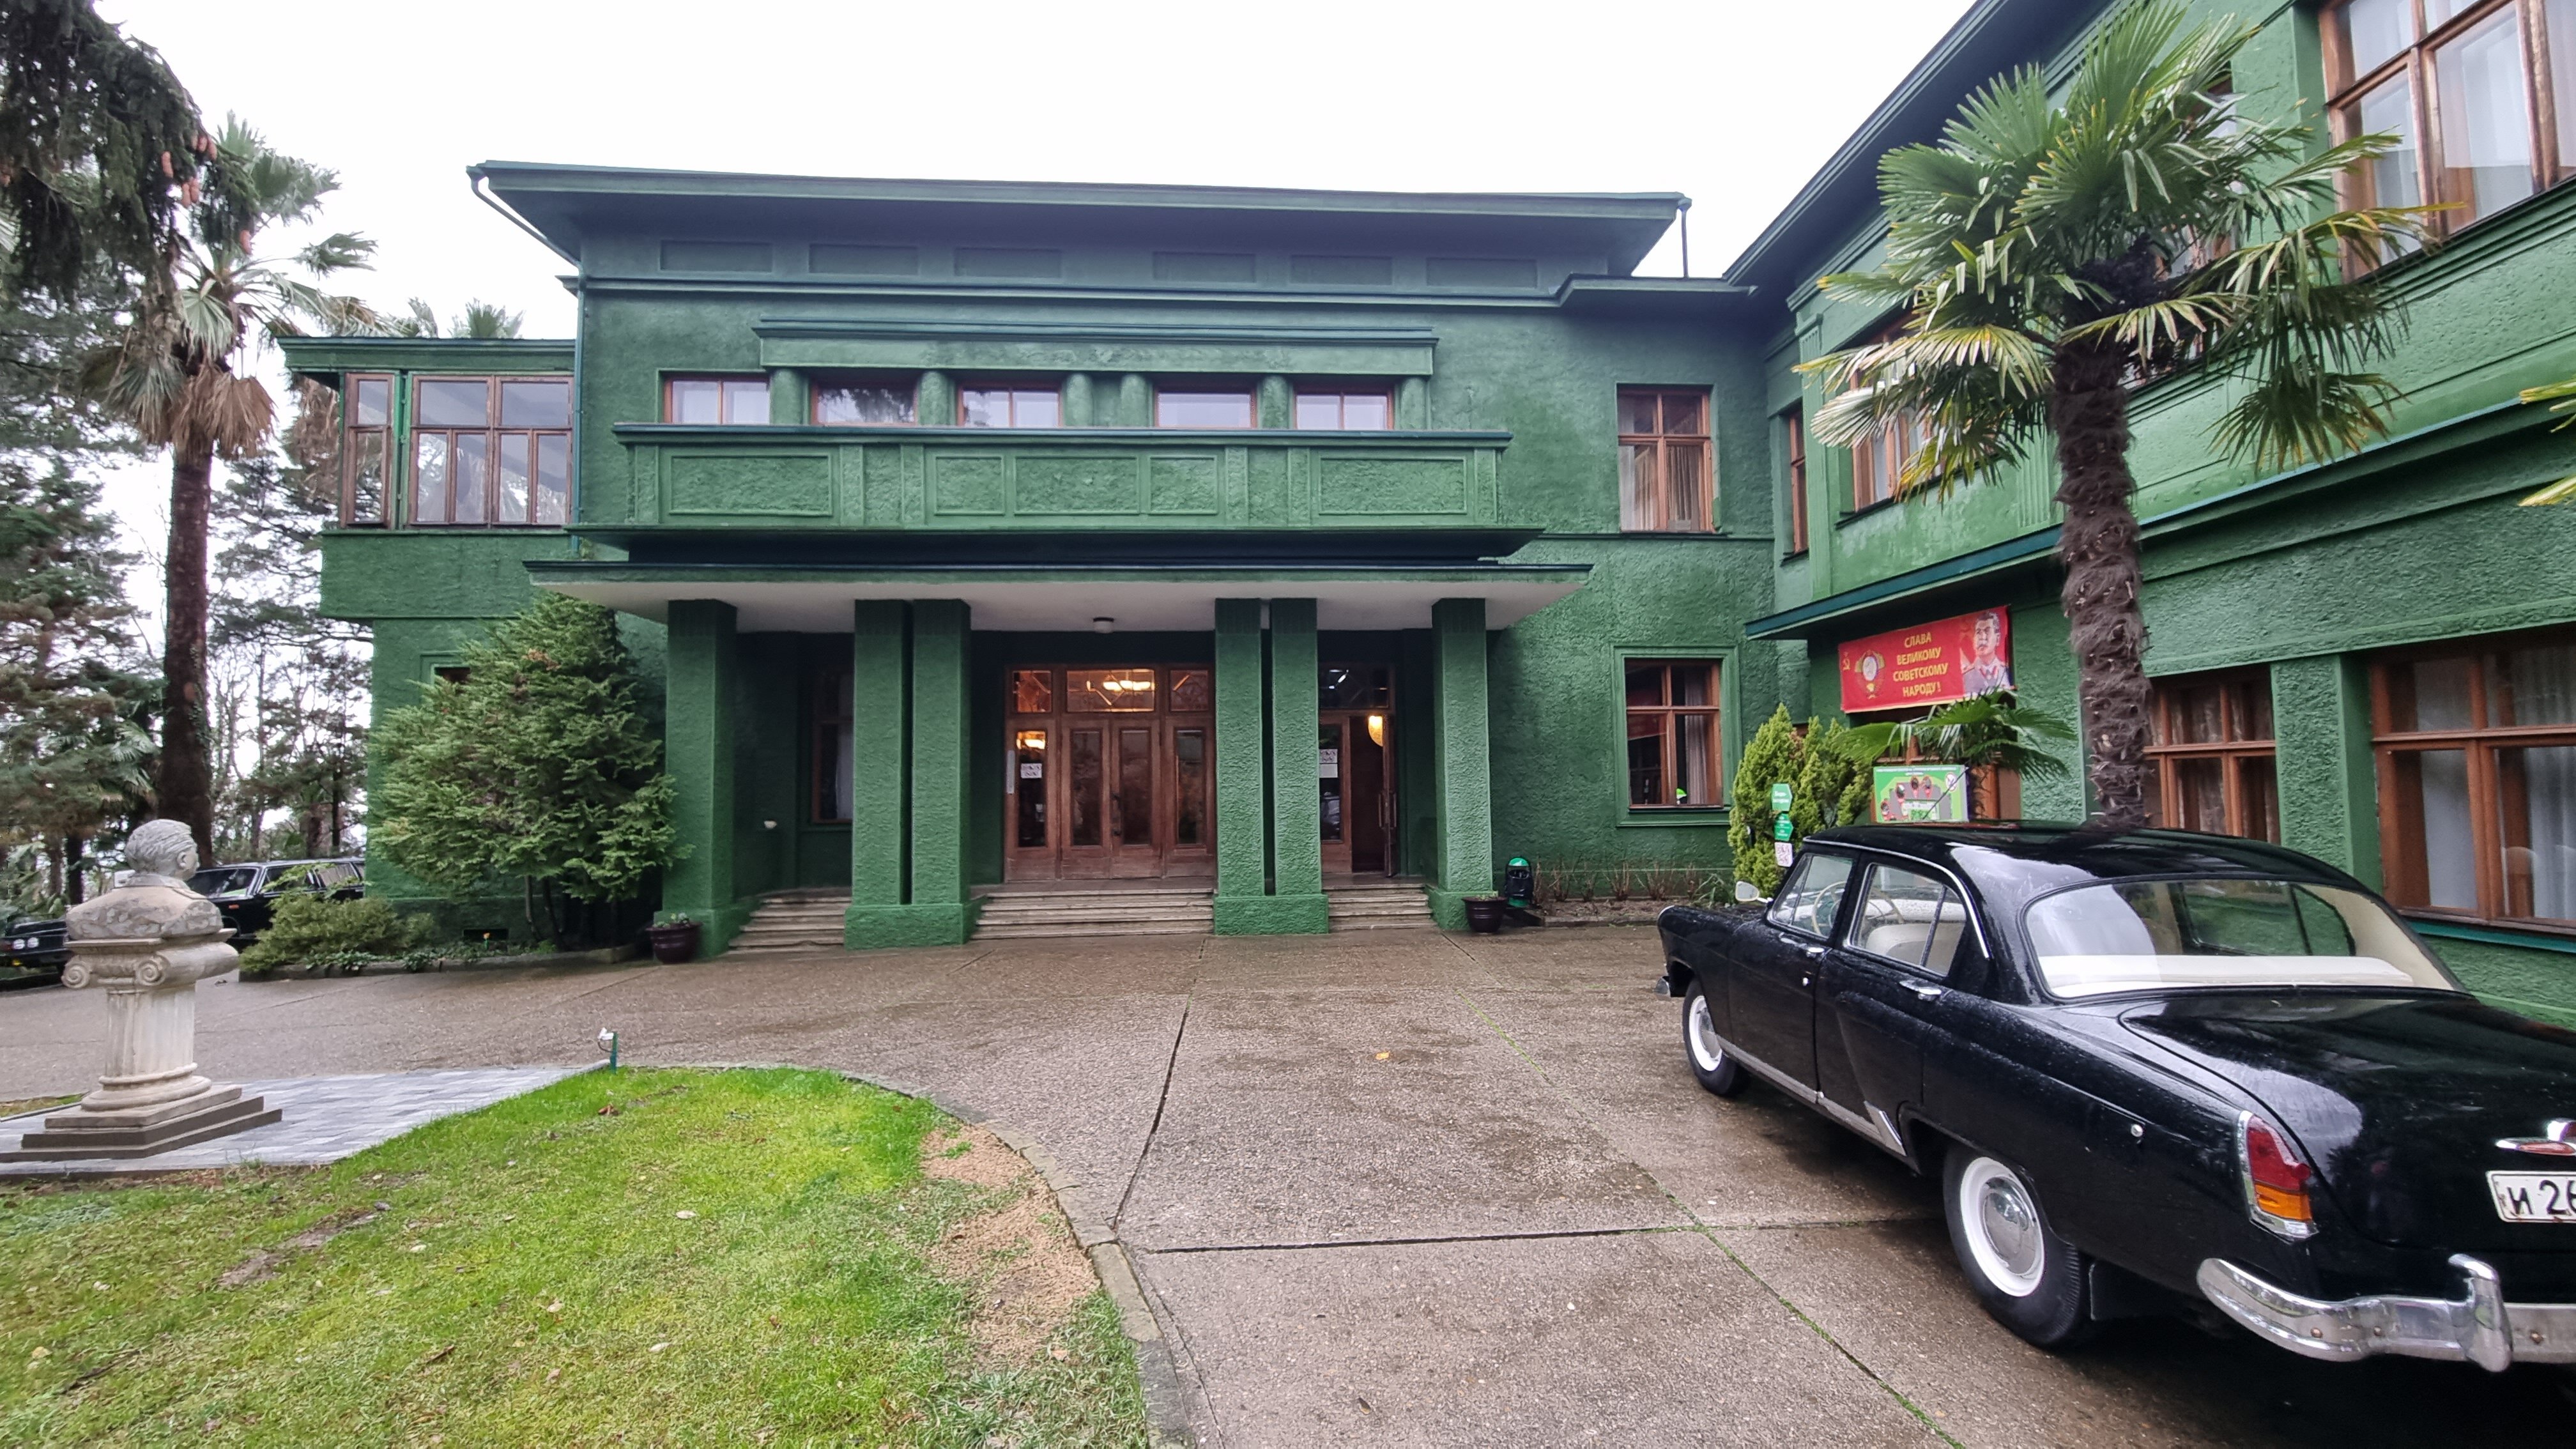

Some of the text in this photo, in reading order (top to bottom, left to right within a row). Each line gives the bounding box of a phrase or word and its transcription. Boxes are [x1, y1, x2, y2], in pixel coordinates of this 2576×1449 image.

[1905, 632, 1931, 648] СЛАВА
[1897, 647, 1941, 665] ВЕЛИКОМУ
[1893, 663, 1948, 682] СОВЕТСКОМУ
[1903, 681, 1941, 697] НАРОДУ!
